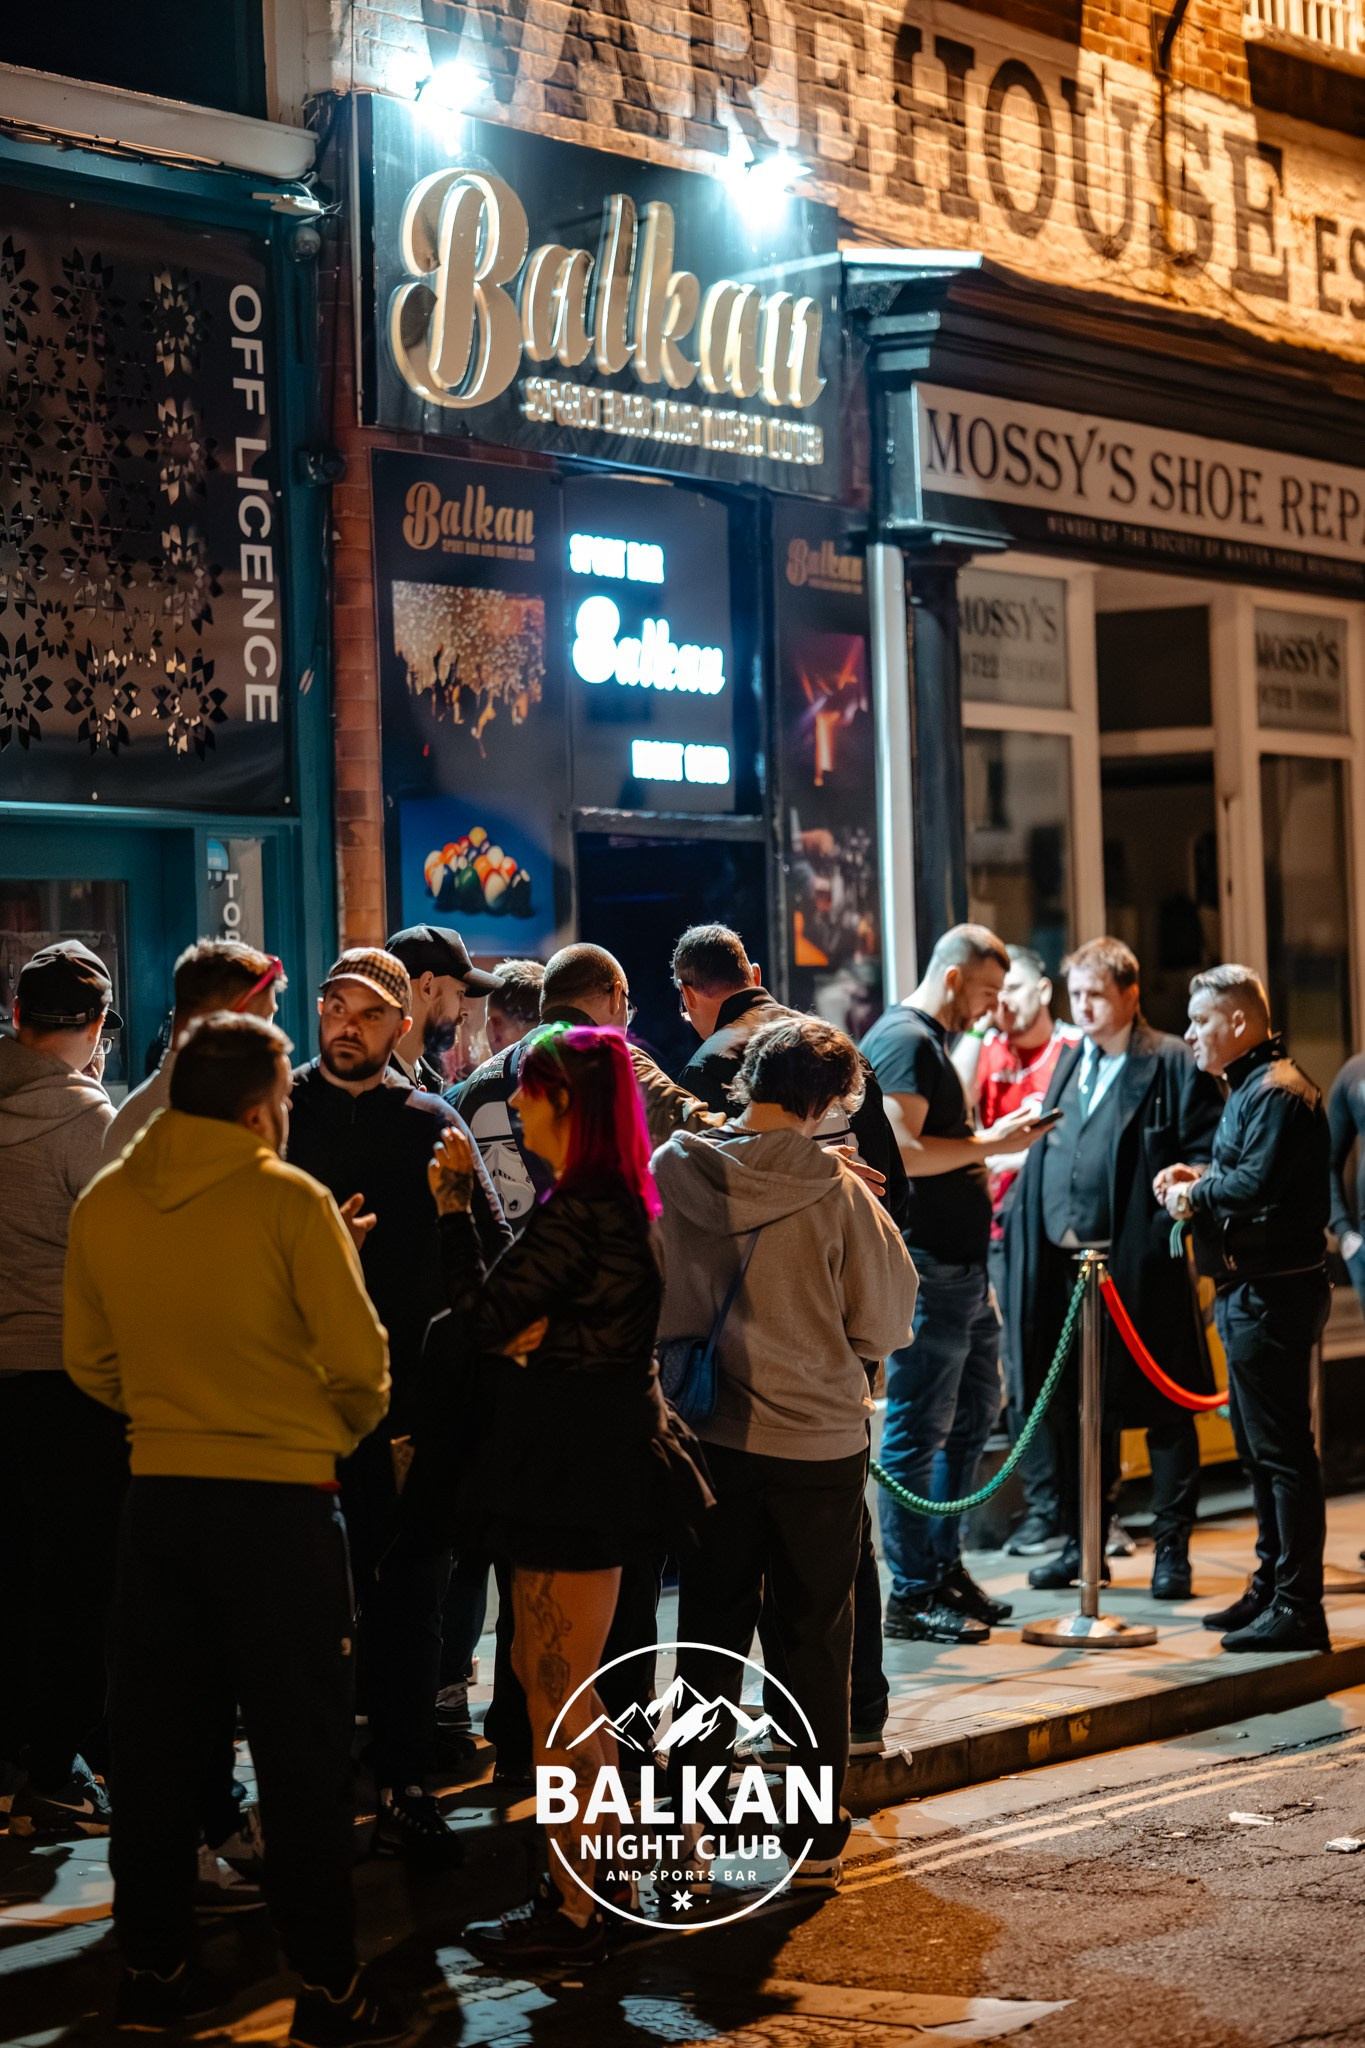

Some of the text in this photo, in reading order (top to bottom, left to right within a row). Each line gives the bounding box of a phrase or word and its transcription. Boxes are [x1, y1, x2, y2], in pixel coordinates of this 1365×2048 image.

[391, 167, 827, 409] Balkan
[229, 284, 278, 723] OFF LICENCE
[403, 481, 535, 550] Balkan
[925, 408, 1365, 546] MOSSY'S SHOE REP
